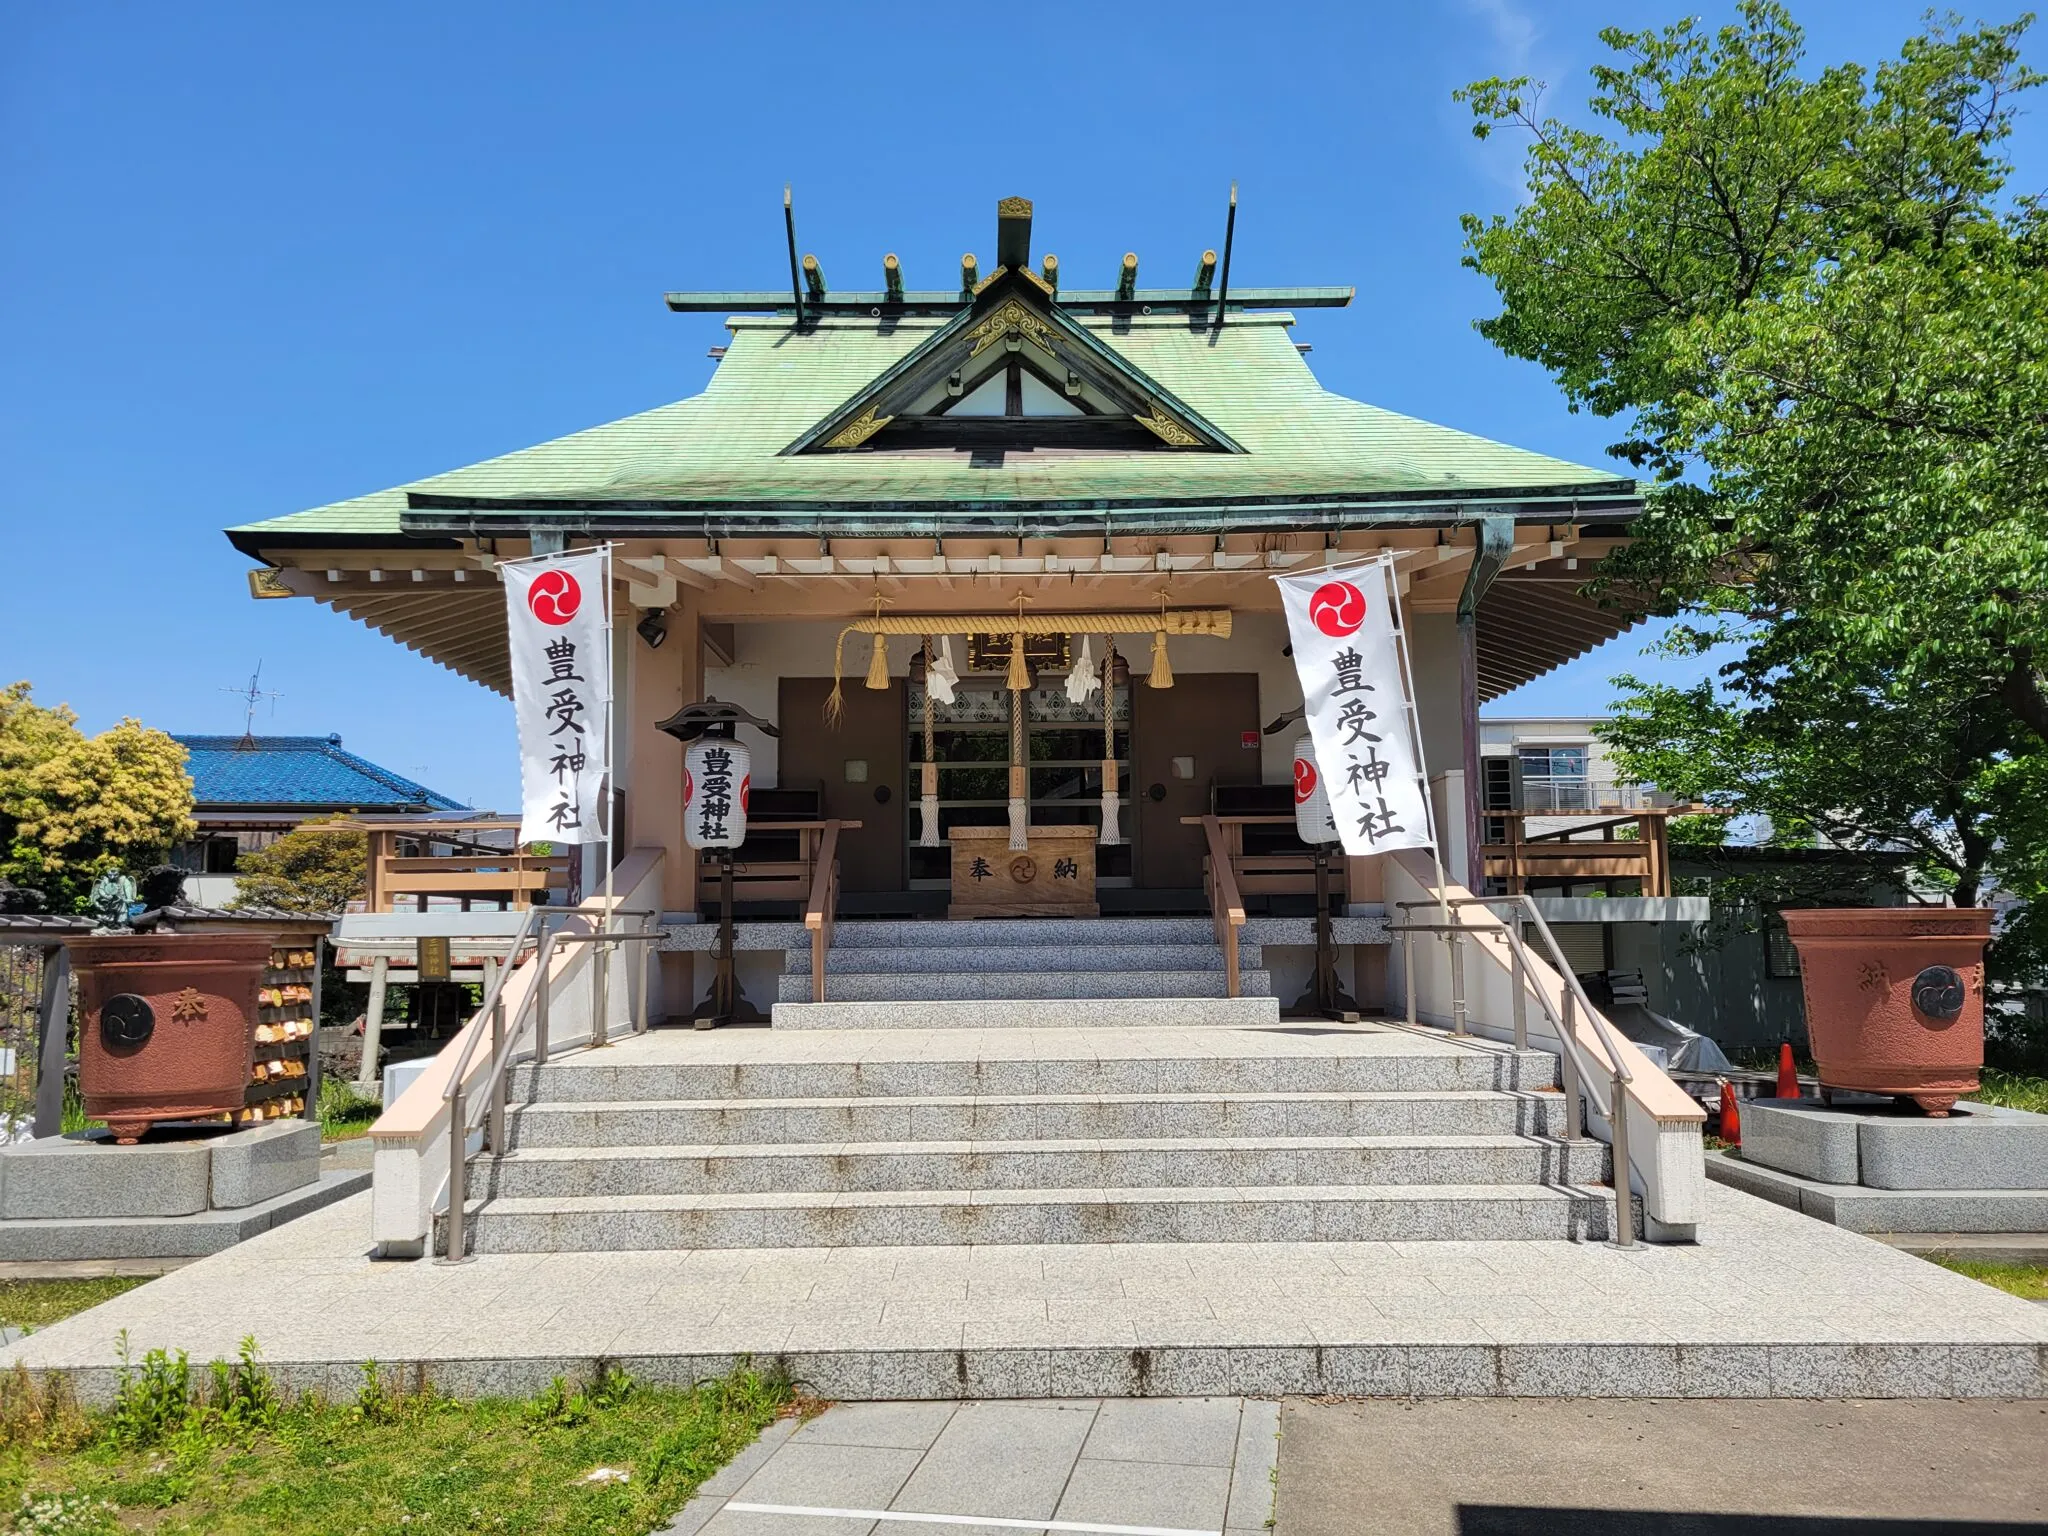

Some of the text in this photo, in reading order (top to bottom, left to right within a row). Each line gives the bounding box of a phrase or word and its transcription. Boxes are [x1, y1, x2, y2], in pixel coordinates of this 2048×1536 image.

[541, 635, 586, 834] 豊受神社
[1330, 646, 1406, 846] 豊受神社
[698, 748, 734, 841] 豊受神社
[969, 856, 1078, 883] 奉 納
[172, 986, 208, 1021] 奉
